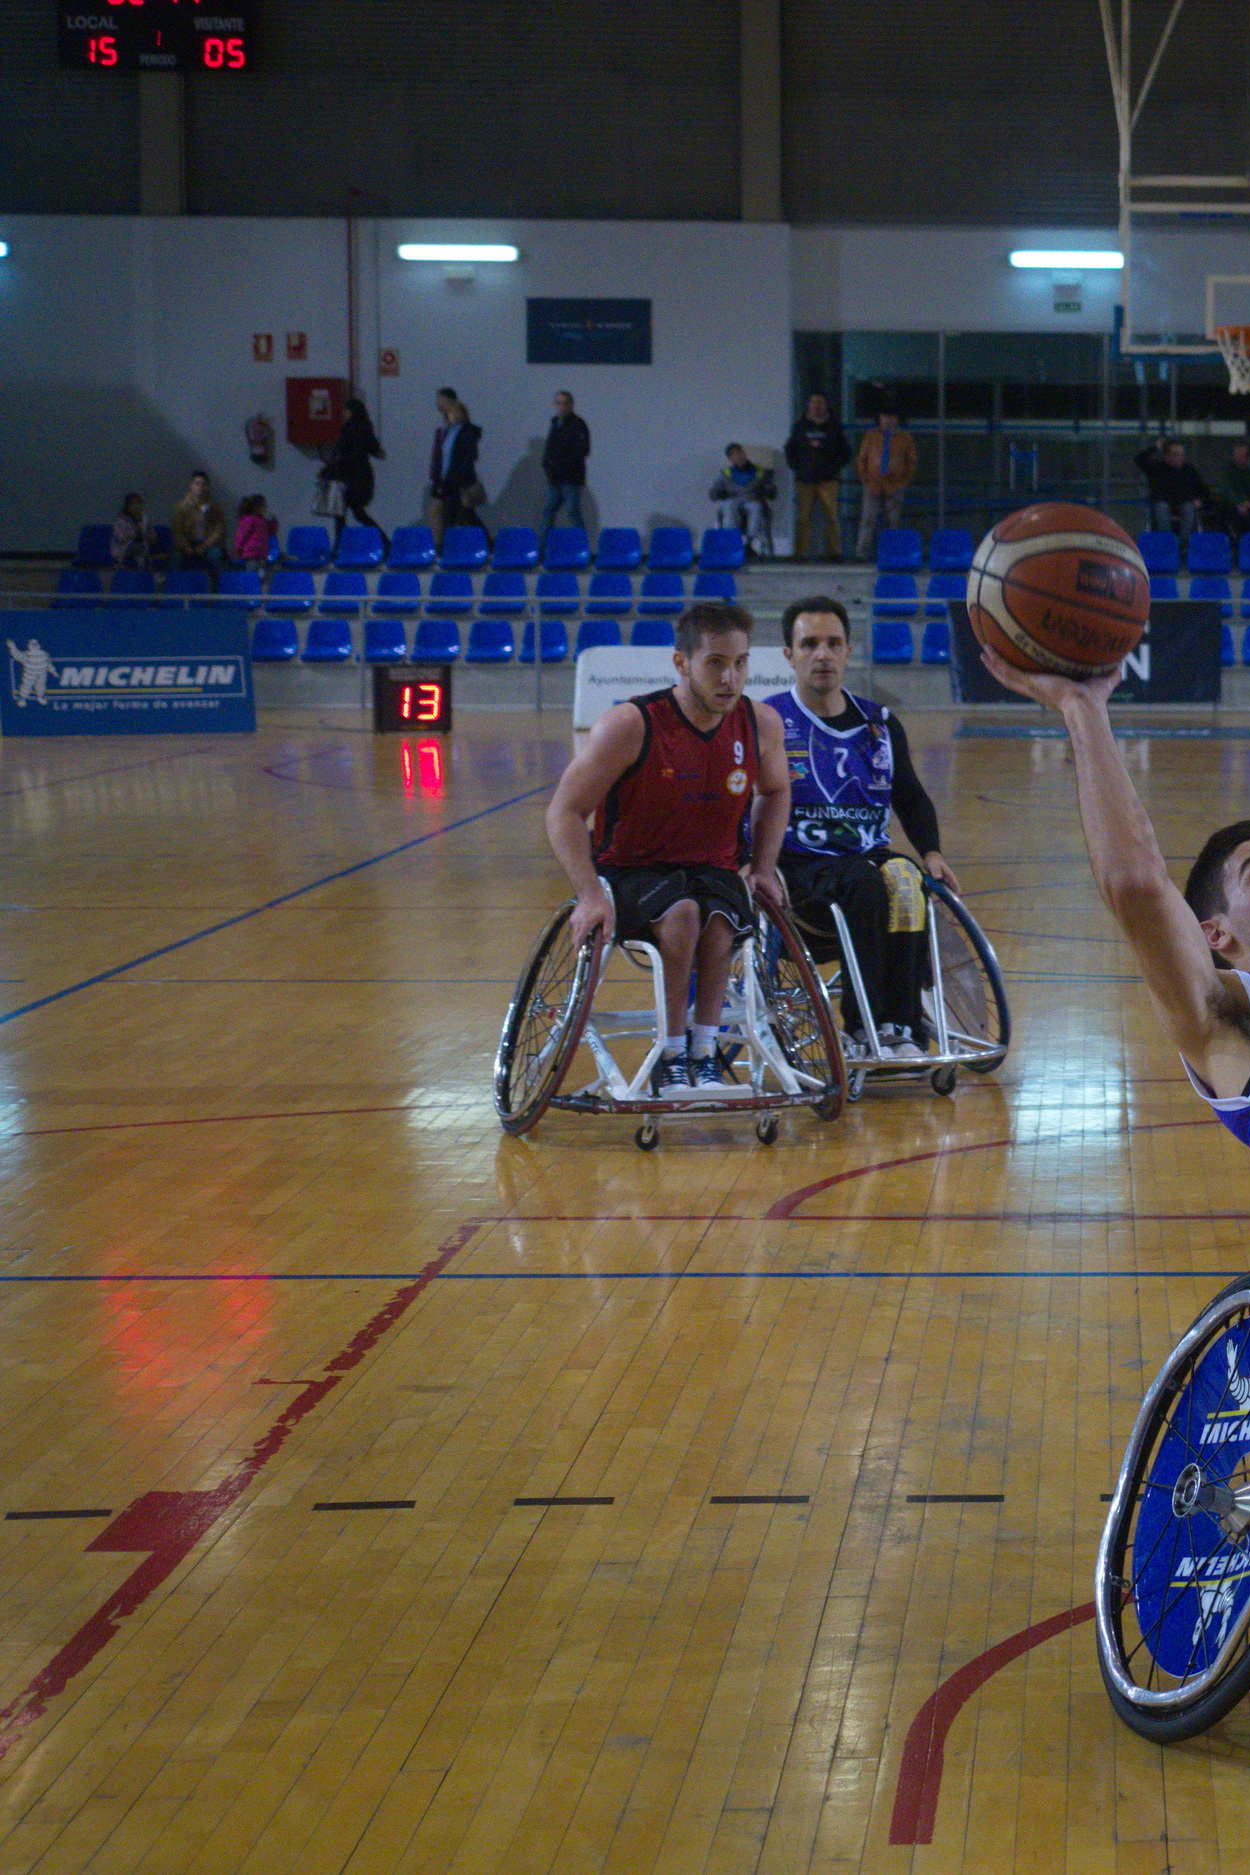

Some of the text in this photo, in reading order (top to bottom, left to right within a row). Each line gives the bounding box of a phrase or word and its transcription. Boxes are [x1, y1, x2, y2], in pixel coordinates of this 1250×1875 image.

[66, 15, 118, 30] LOCAL
[89, 36, 118, 66] 15
[203, 37, 246, 68] 05
[59, 664, 236, 687] MICHELIN
[745, 673, 795, 686] alladoli
[401, 684, 443, 721] 13
[733, 740, 744, 765] 9
[833, 746, 849, 779] 7
